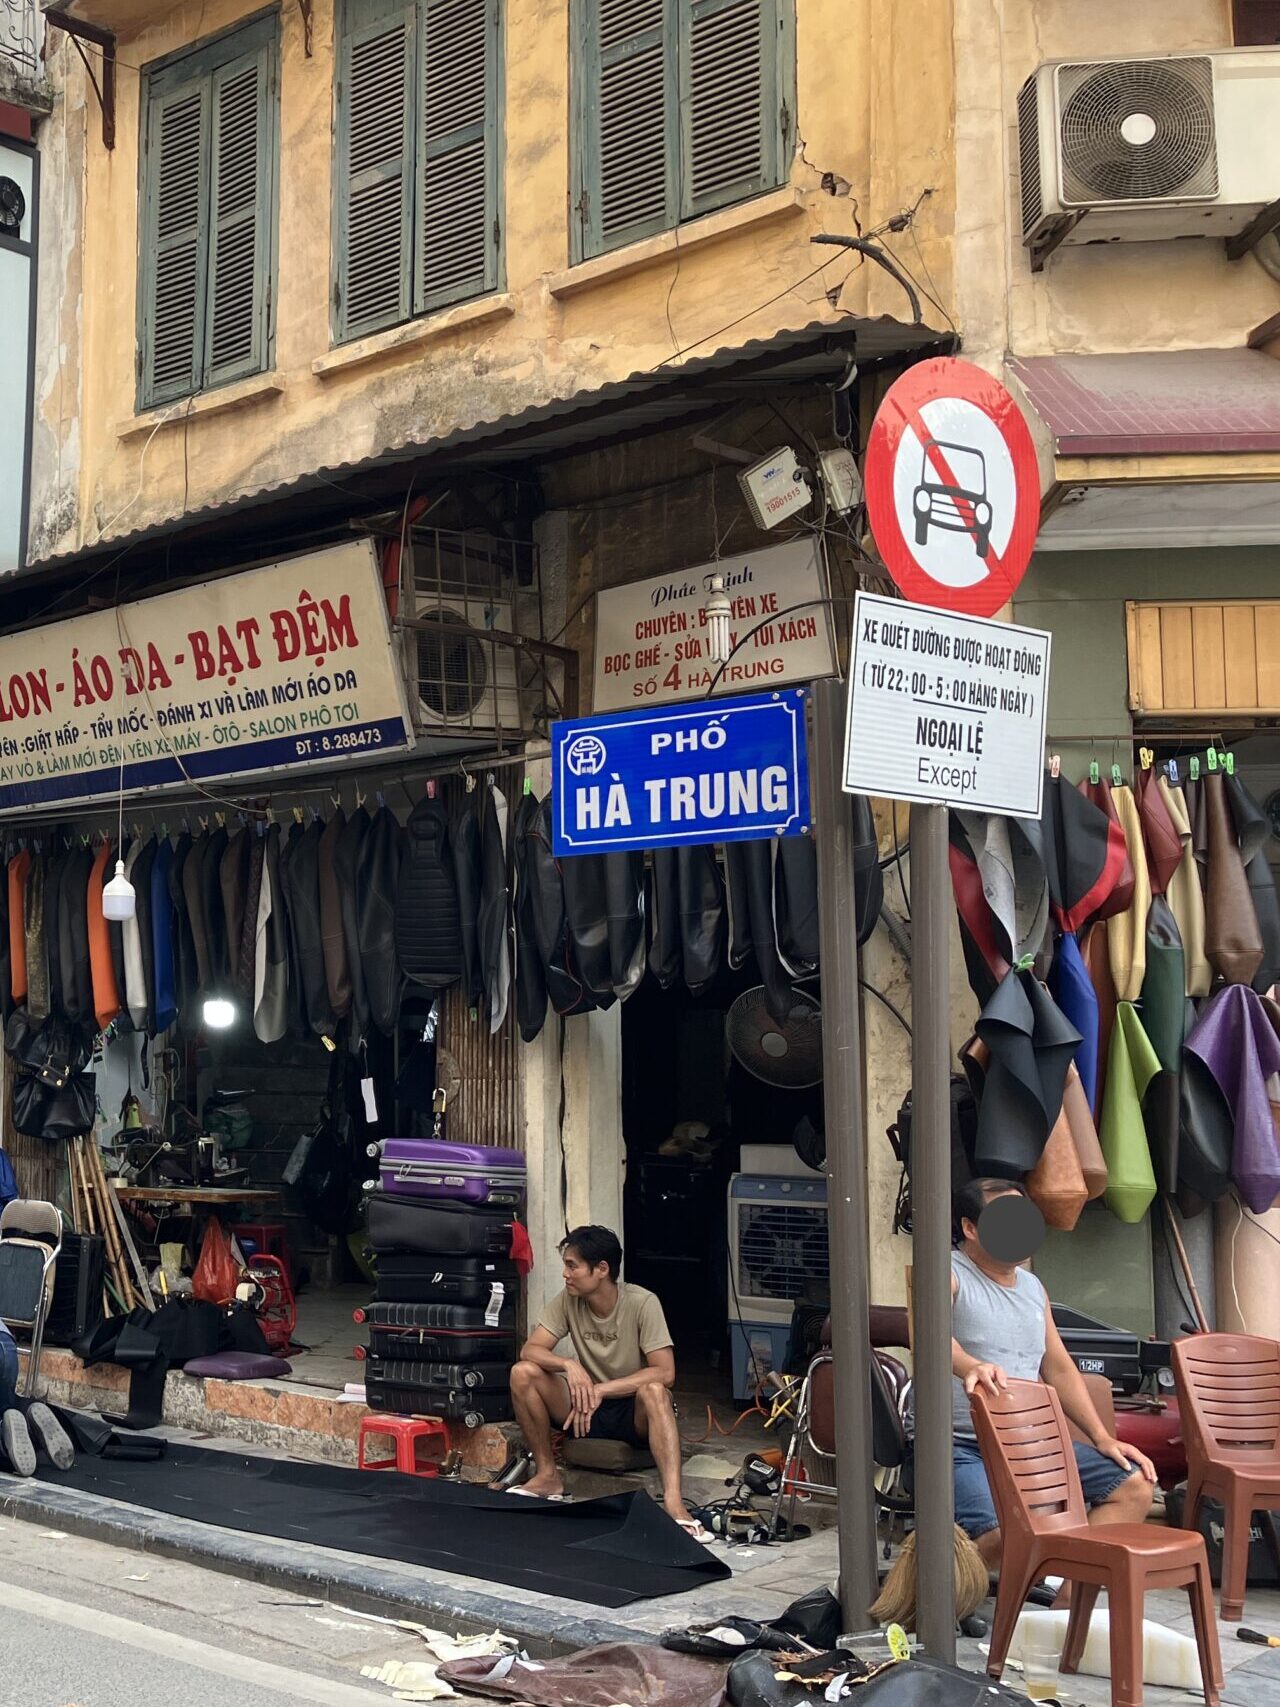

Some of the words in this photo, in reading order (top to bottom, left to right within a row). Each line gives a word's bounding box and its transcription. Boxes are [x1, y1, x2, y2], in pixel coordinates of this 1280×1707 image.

[767, 486, 801, 513] 19001515
[651, 582, 697, 607] Phúc
[703, 566, 753, 592] Tịnh
[635, 610, 687, 640] CHUYÊN
[730, 596, 756, 620] YÊN
[760, 592, 778, 614] XE
[71, 648, 113, 707] ÁO
[119, 641, 172, 695] DA
[188, 617, 261, 686] BẠT
[270, 589, 359, 667] ĐỆM
[604, 652, 631, 677] BỌC
[635, 641, 663, 667] GHẾ
[674, 633, 701, 662] SỬA
[779, 617, 817, 643] XÁCH
[863, 618, 878, 643] XE
[882, 621, 909, 650] QUÉT
[912, 626, 950, 658] ĐƯỜNG
[953, 637, 982, 668] ĐƯỢC
[984, 644, 1012, 674] HOẠT
[1013, 647, 1041, 679] ĐỘNG
[633, 674, 657, 697] SỐ
[663, 663, 681, 691] 4
[688, 669, 713, 689] HÀ
[721, 659, 784, 682] TRUNG
[871, 660, 887, 688] TỪ
[968, 678, 997, 708] HÀNG
[1000, 686, 1027, 714] NGÀY
[55, 721, 79, 746] HẤP
[90, 713, 113, 739] TẨY
[118, 707, 148, 734] MỐC
[157, 702, 195, 727] ĐÁNH
[198, 700, 213, 719] XI
[215, 691, 235, 715] VÀ
[237, 687, 268, 712] LÀM
[272, 675, 304, 705] MỚI
[307, 671, 331, 698] ÁO
[334, 669, 358, 692] DA
[16, 756, 34, 777] VỎ
[37, 761, 44, 775] &
[46, 752, 71, 773] LÀM
[72, 746, 97, 769] MỚI
[99, 744, 126, 766] ĐỆM
[128, 738, 153, 759] YÊN
[154, 737, 172, 754] XE
[173, 727, 201, 751] MÁY
[212, 721, 240, 744] ÔTÔ
[249, 711, 297, 740] SALON
[301, 705, 332, 729] PHÔ
[335, 702, 360, 722] TƠI
[322, 728, 381, 751] 8.288473
[651, 714, 730, 755] PHỐ
[916, 717, 963, 756] NGOẠI
[967, 721, 983, 760] LỆ
[576, 773, 632, 830] HÀ
[644, 765, 788, 823] TRUNG
[918, 757, 977, 795] Except
[583, 1331, 618, 1341] GUSS
